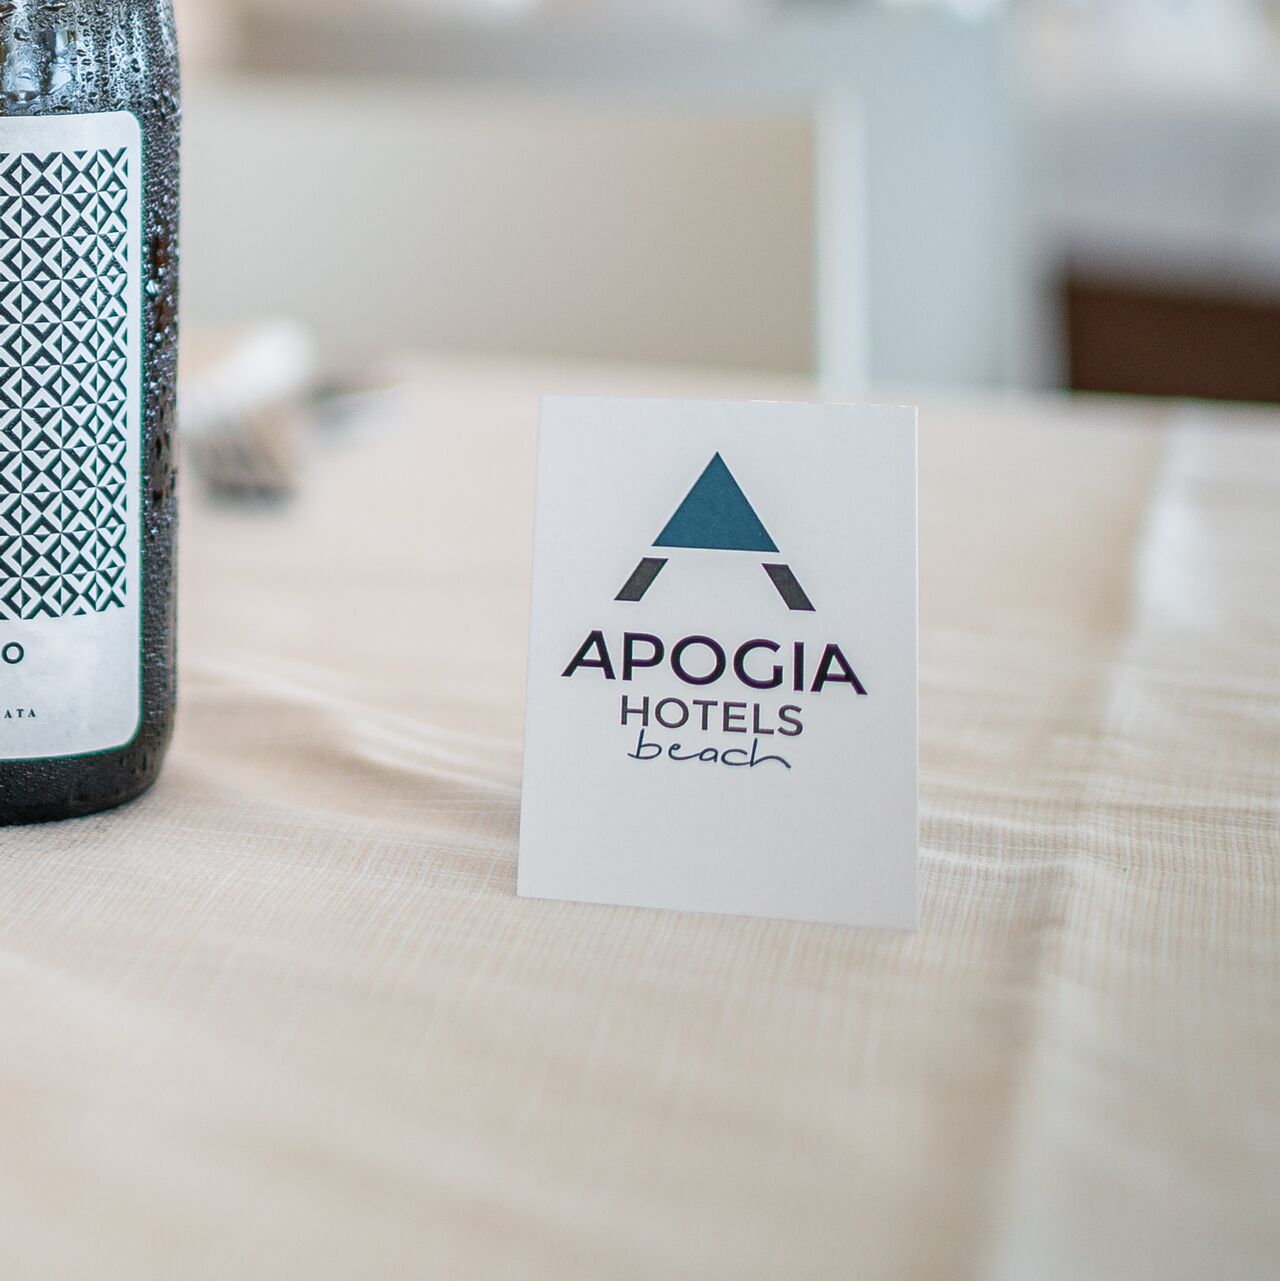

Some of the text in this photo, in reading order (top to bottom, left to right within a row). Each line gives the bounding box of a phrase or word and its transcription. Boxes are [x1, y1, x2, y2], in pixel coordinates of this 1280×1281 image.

[560, 630, 868, 695] APOGIA
[619, 694, 804, 737] HOTELS
[626, 728, 792, 770] beach
